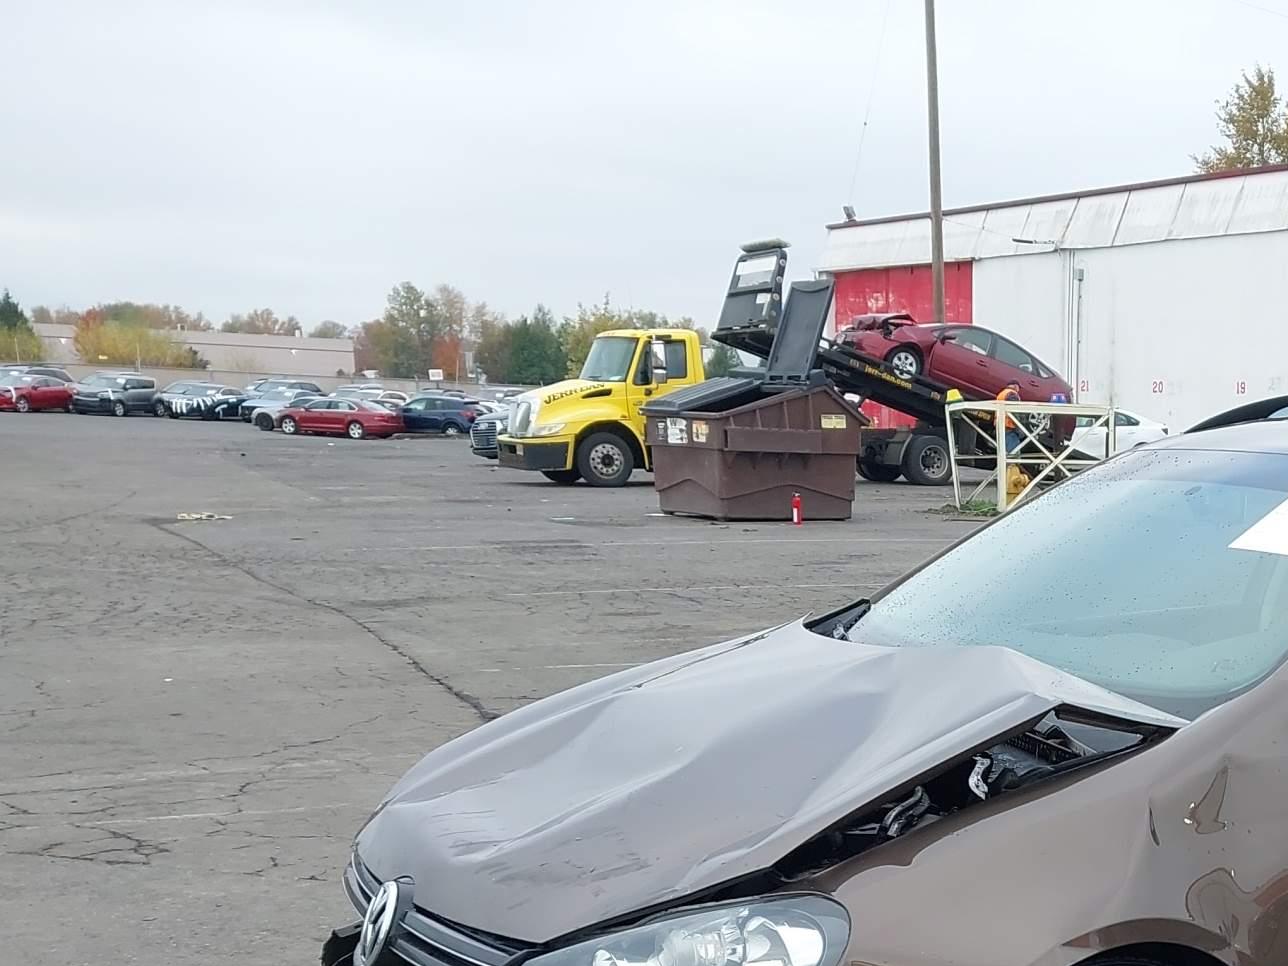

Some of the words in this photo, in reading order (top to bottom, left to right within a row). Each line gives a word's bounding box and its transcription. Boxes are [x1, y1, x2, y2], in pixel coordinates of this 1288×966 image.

[1080, 380, 1089, 392] 21
[1152, 381, 1164, 393] 20
[1236, 381, 1246, 394] 19
